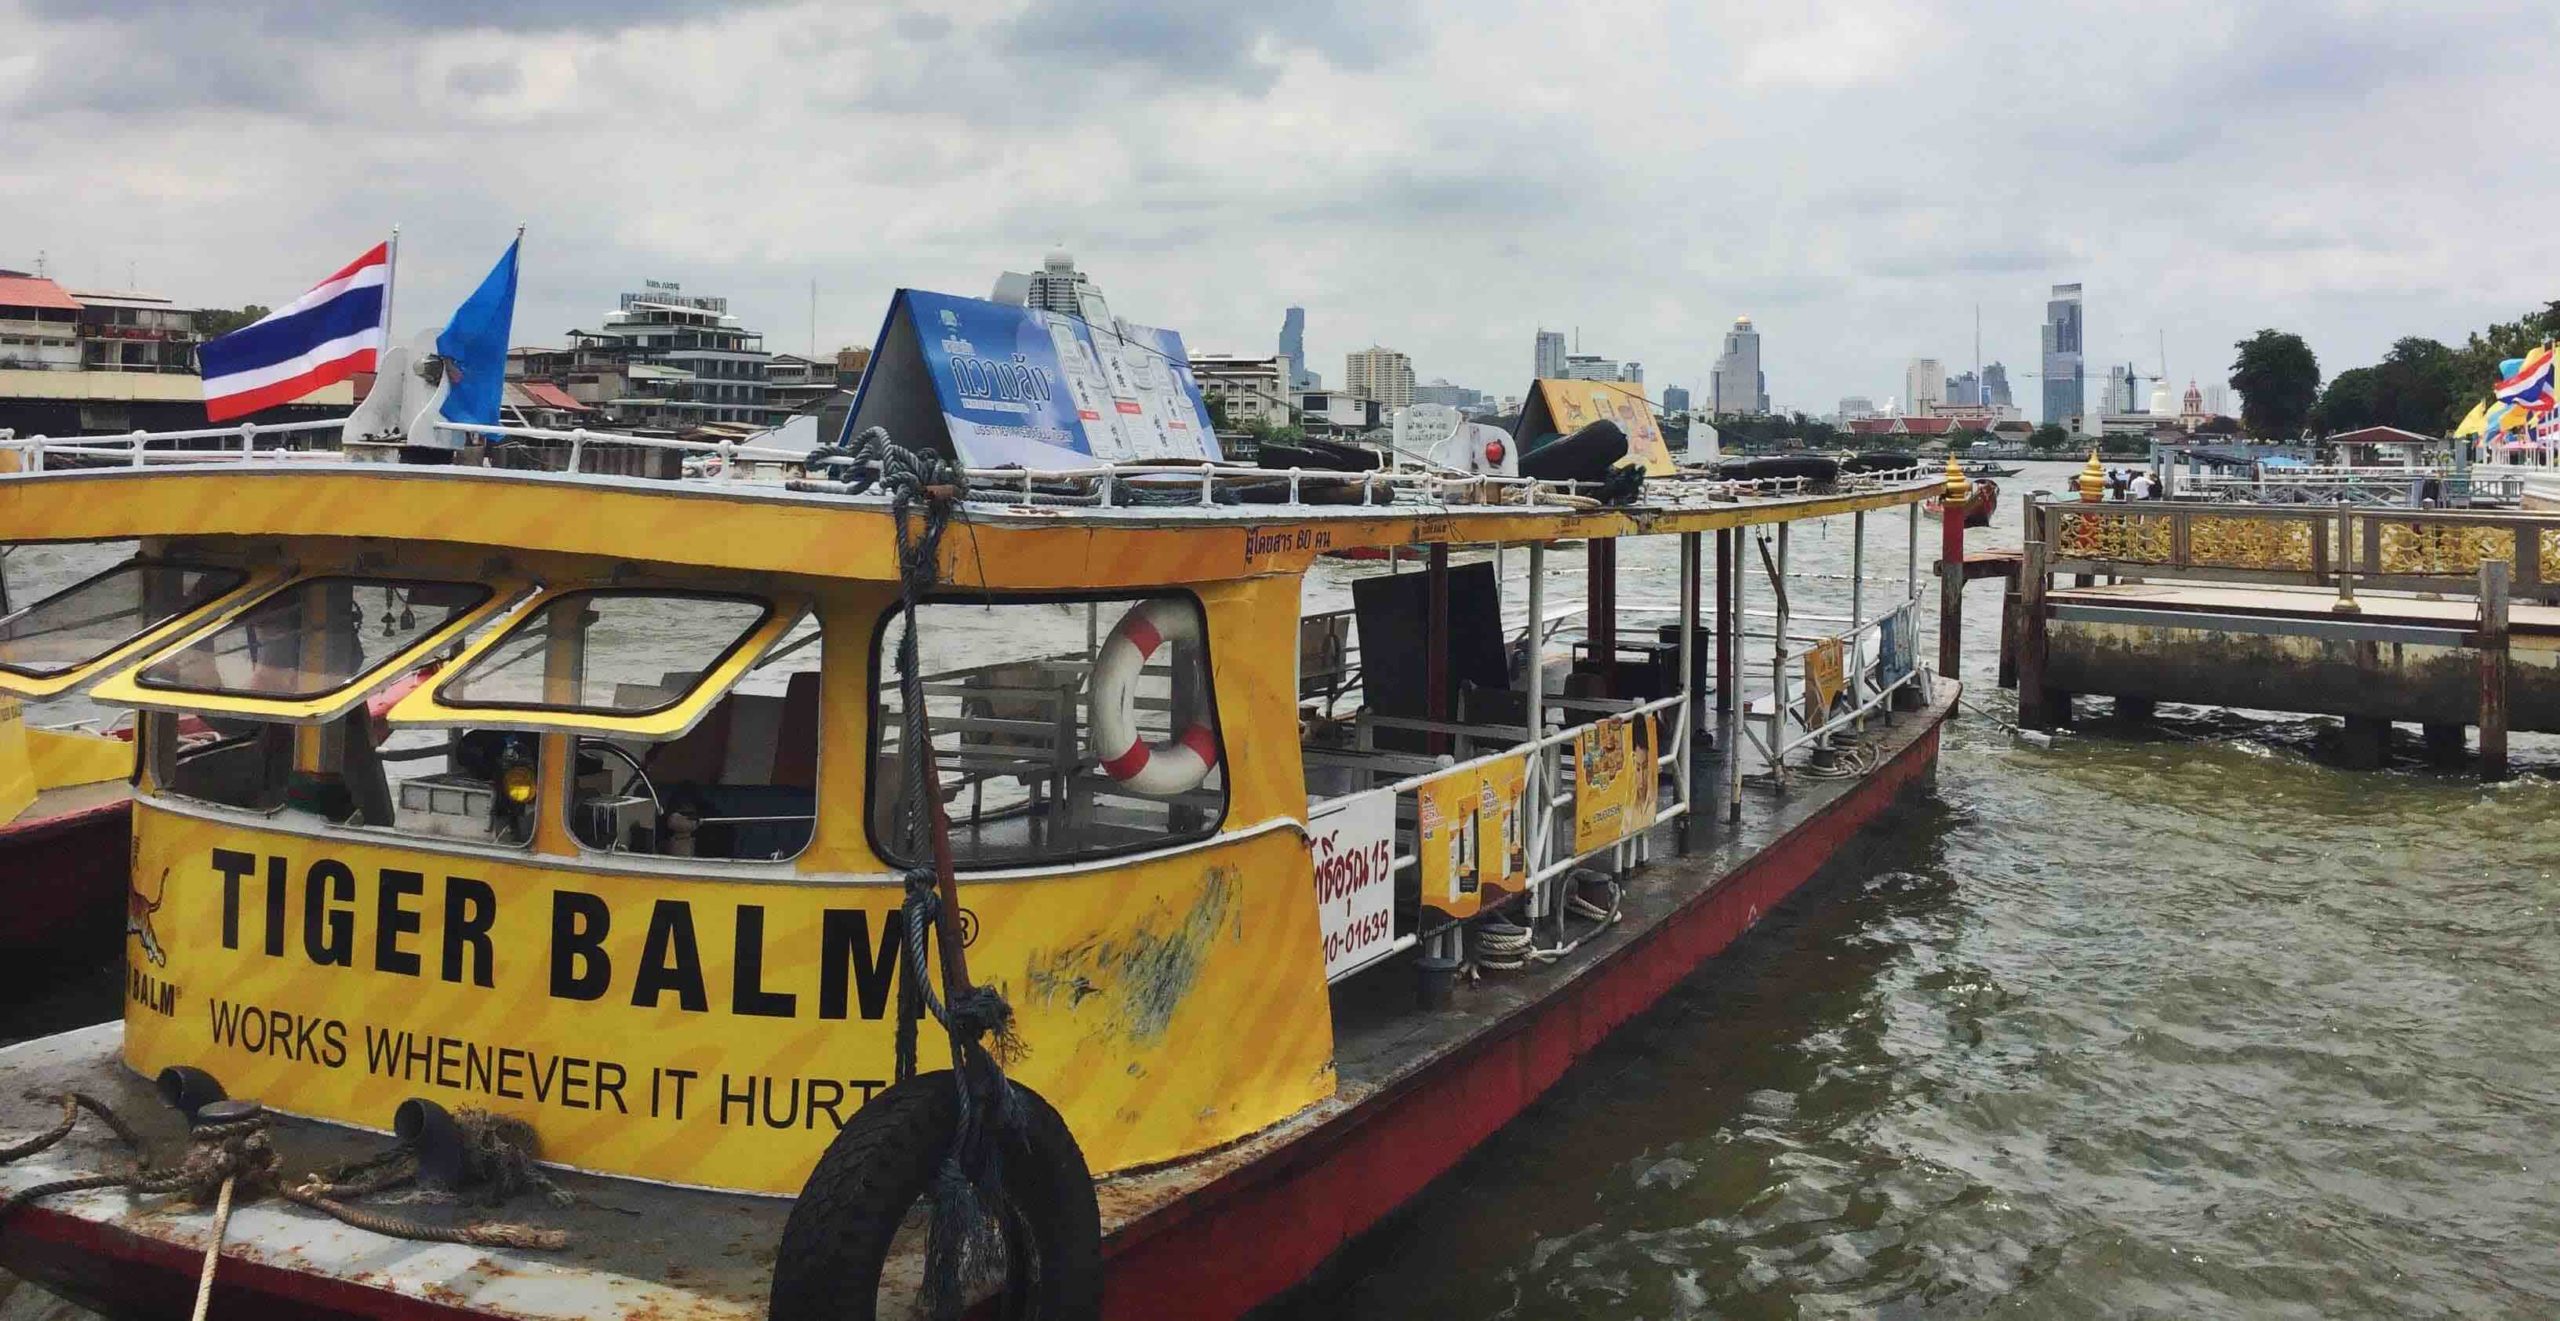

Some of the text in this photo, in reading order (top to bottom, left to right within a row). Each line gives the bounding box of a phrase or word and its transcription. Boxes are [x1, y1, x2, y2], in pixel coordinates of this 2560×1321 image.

[1314, 530, 1330, 549] คน
[1309, 829, 1389, 917] พธิ์อรุณ 15
[212, 847, 927, 1020] TIGER BALM
[1322, 908, 1389, 966] 10-01639
[133, 967, 175, 1018] BALM
[209, 998, 347, 1069] WORKS
[365, 1025, 628, 1115] WHENEVER
[651, 1067, 698, 1121] IT
